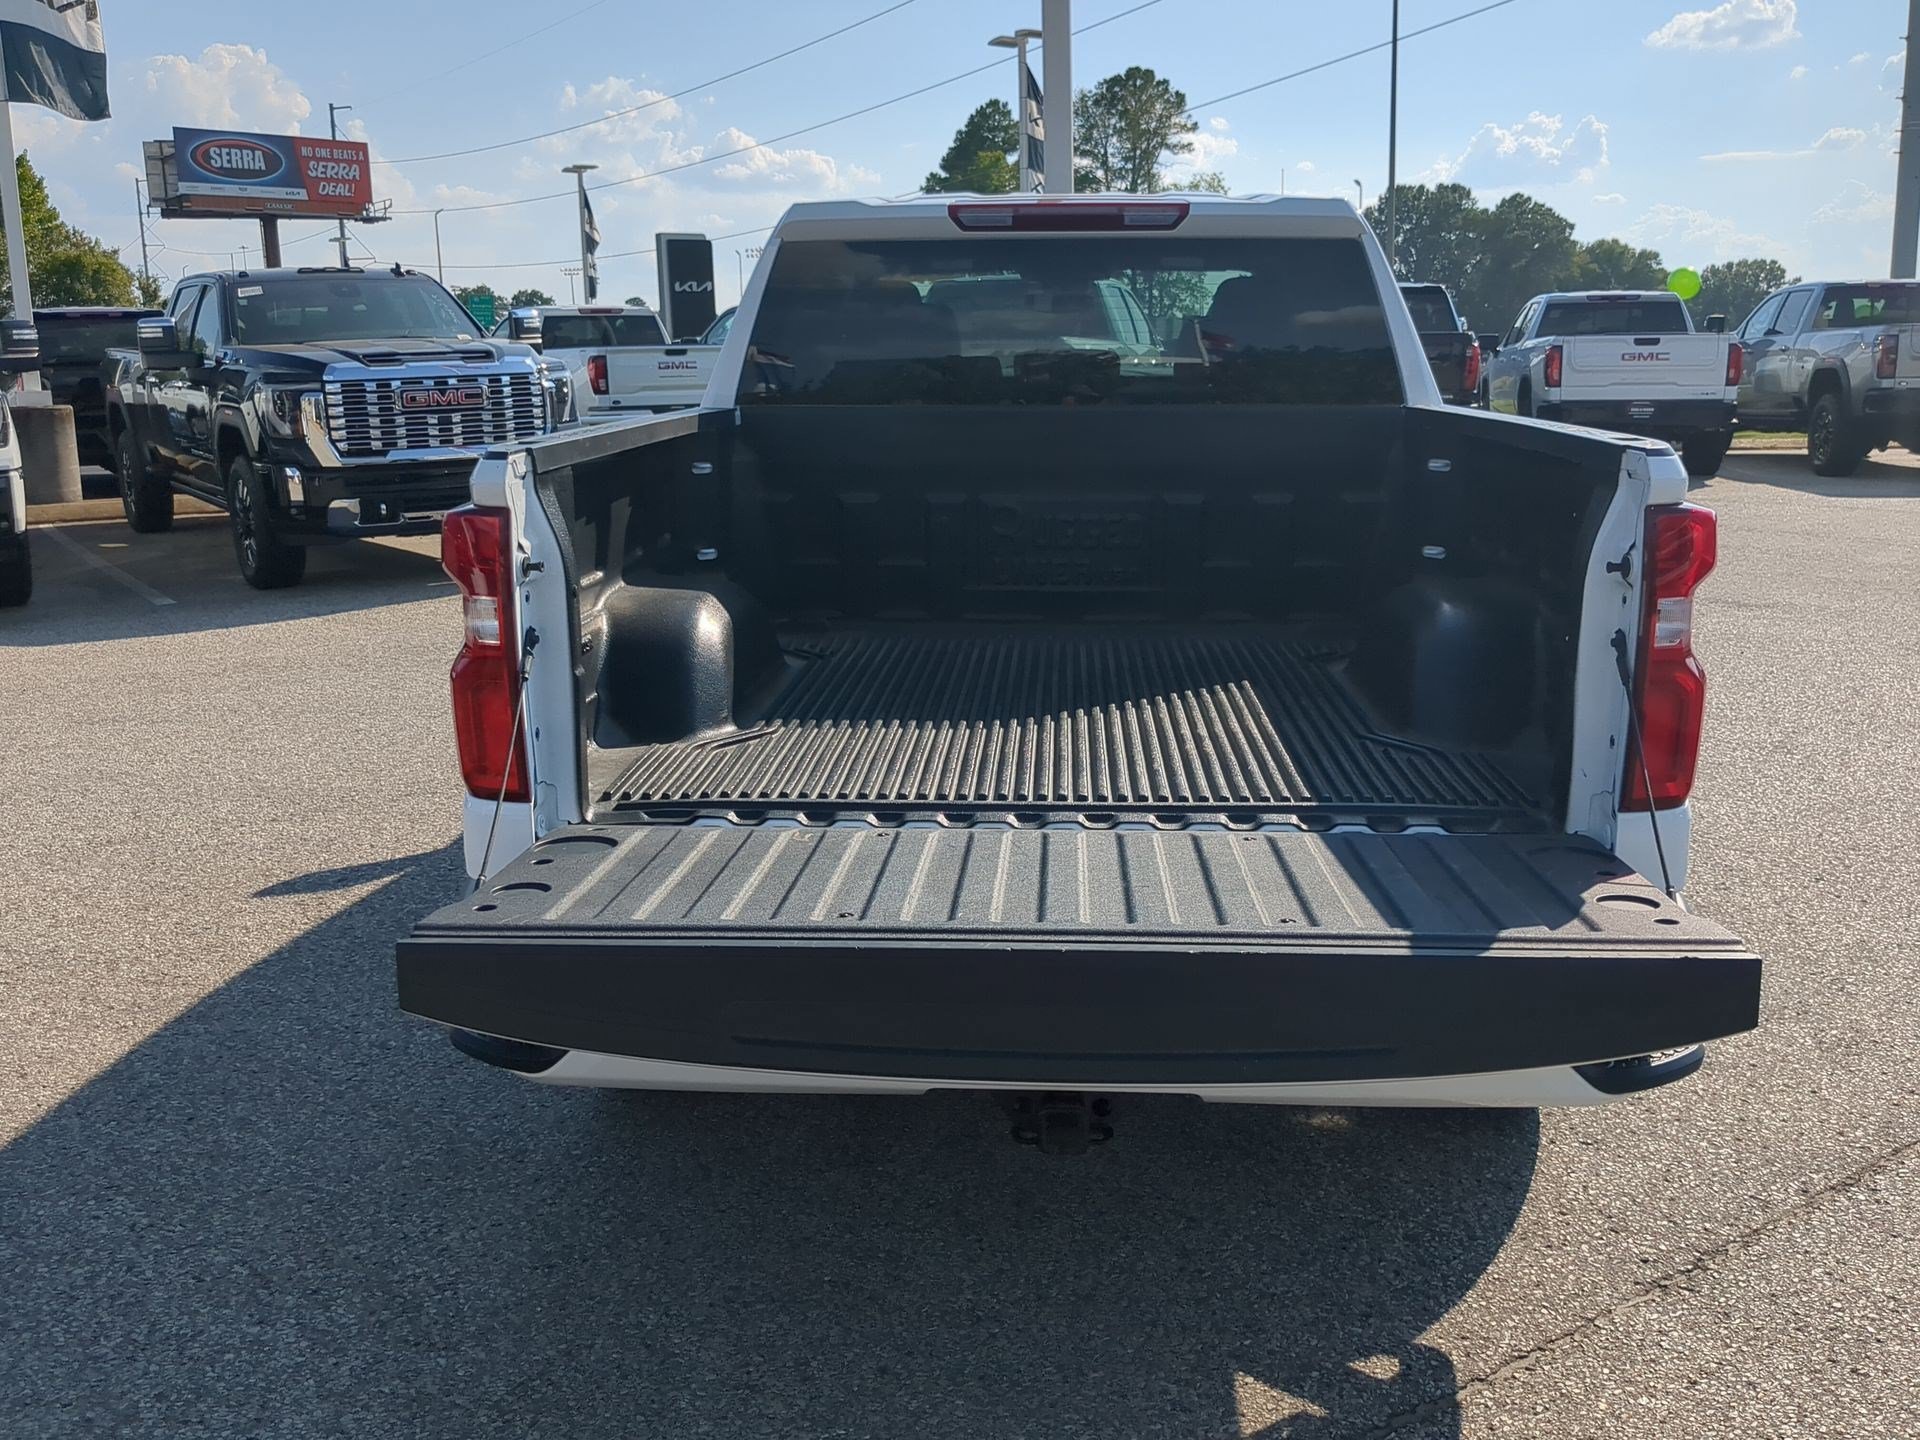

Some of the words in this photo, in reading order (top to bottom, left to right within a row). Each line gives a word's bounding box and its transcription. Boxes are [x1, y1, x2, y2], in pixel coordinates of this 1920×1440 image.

[209, 146, 266, 170] SERRA
[301, 146, 313, 157] NO
[315, 147, 331, 159] ONE
[333, 149, 357, 160] BEATS
[358, 151, 364, 160] A
[307, 160, 360, 180] SERRA
[318, 181, 355, 197] DEAL!
[674, 281, 712, 292] KIA
[1621, 352, 1670, 361] GMC
[658, 361, 697, 369] GMC
[403, 388, 483, 407] GMC
